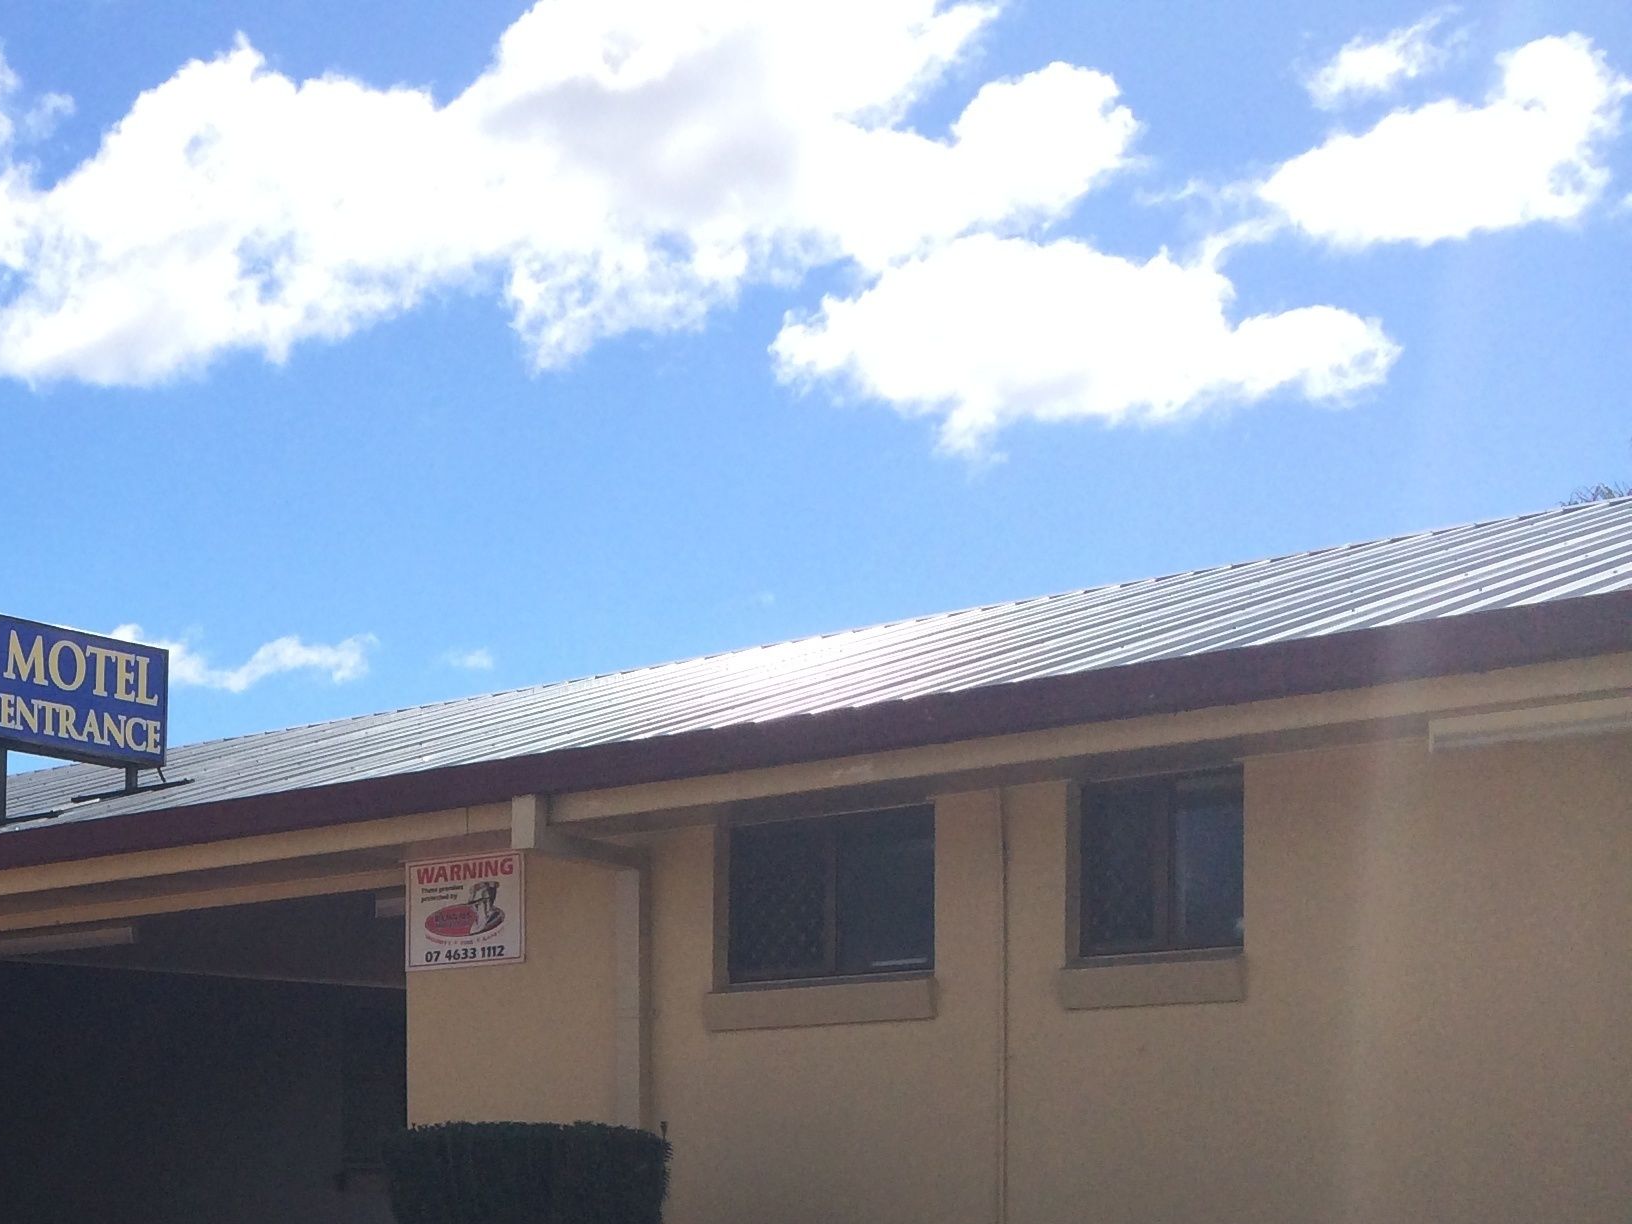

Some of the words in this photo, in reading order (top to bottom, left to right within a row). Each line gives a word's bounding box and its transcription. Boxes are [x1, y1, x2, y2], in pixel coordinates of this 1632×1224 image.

[3, 630, 159, 706] MOTEL
[0, 693, 161, 754] ENTRANCE
[417, 858, 514, 885] WARNING
[425, 951, 441, 963] 07
[445, 948, 477, 961] 4633
[481, 945, 505, 958] 1112
